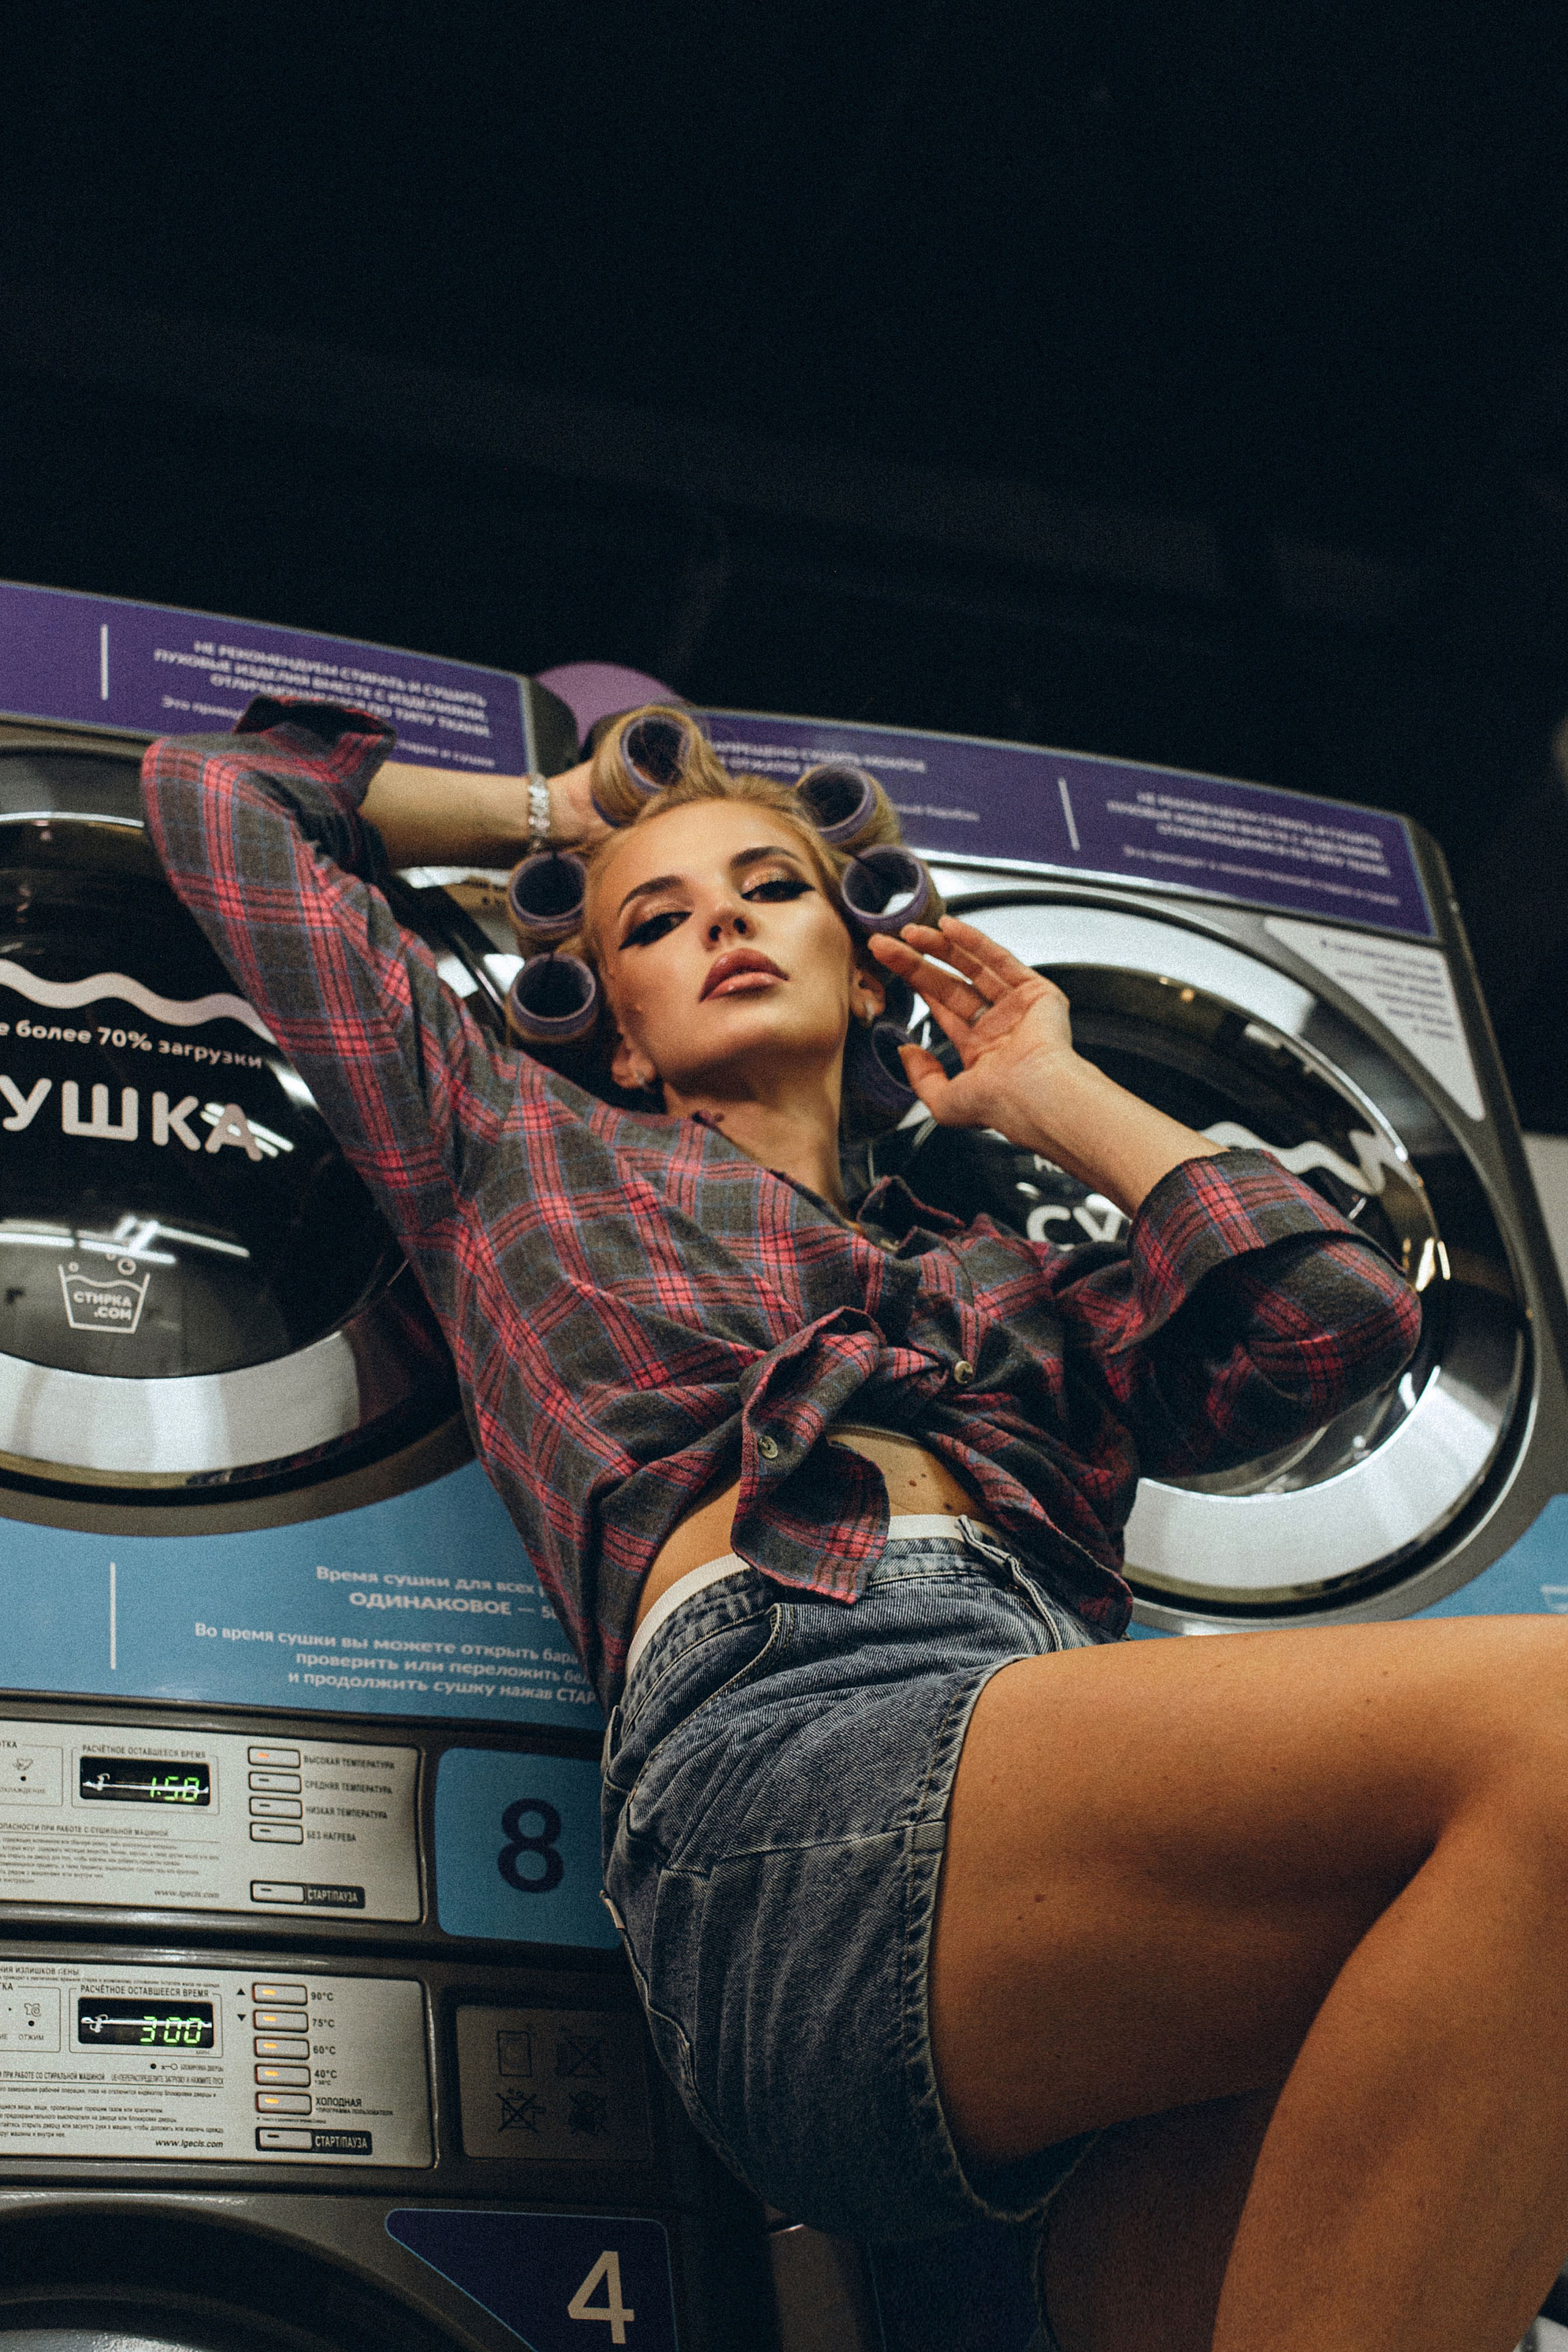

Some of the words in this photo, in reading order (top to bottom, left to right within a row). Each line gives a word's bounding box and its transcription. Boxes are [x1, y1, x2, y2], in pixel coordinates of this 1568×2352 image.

[15, 1019, 92, 1044] более
[97, 1026, 153, 1051] 70%
[158, 1039, 263, 1069] загрузки
[0, 1074, 263, 1163] УШКА
[73, 1291, 132, 1308] СТИРКА
[316, 1566, 379, 1583] Время
[383, 1574, 450, 1589] сушки
[454, 1578, 492, 1592] для
[496, 1581, 535, 1595] всех
[349, 1592, 512, 1615] ОДИНАКОВОЕ
[195, 1623, 218, 1638] Во
[222, 1628, 274, 1643] время
[277, 1632, 336, 1648] сушки
[341, 1637, 368, 1649] вы
[373, 1640, 456, 1655] можете
[461, 1643, 539, 1660] открыть
[296, 1653, 399, 1671] проверить
[404, 1660, 444, 1673] или
[449, 1662, 560, 1684] переложить
[288, 1672, 300, 1683] и
[304, 1673, 429, 1693] продолжить
[432, 1681, 496, 1698] сушку
[499, 1684, 552, 1701] нажав
[497, 1797, 565, 1894] 8
[80, 1984, 126, 1994] РАСЧЁТНОЕ
[128, 1986, 180, 1996] ОСТАВШЕЕСЯ
[183, 1989, 209, 1997] ВРЕМЯ
[310, 1991, 334, 2001] 90°C
[312, 2019, 335, 2028] 75°C
[313, 2046, 336, 2055] 60°C
[314, 2070, 337, 2079] 40°C
[315, 2097, 362, 2107] ХОЛОДНАЯ
[567, 2250, 635, 2345] 4
